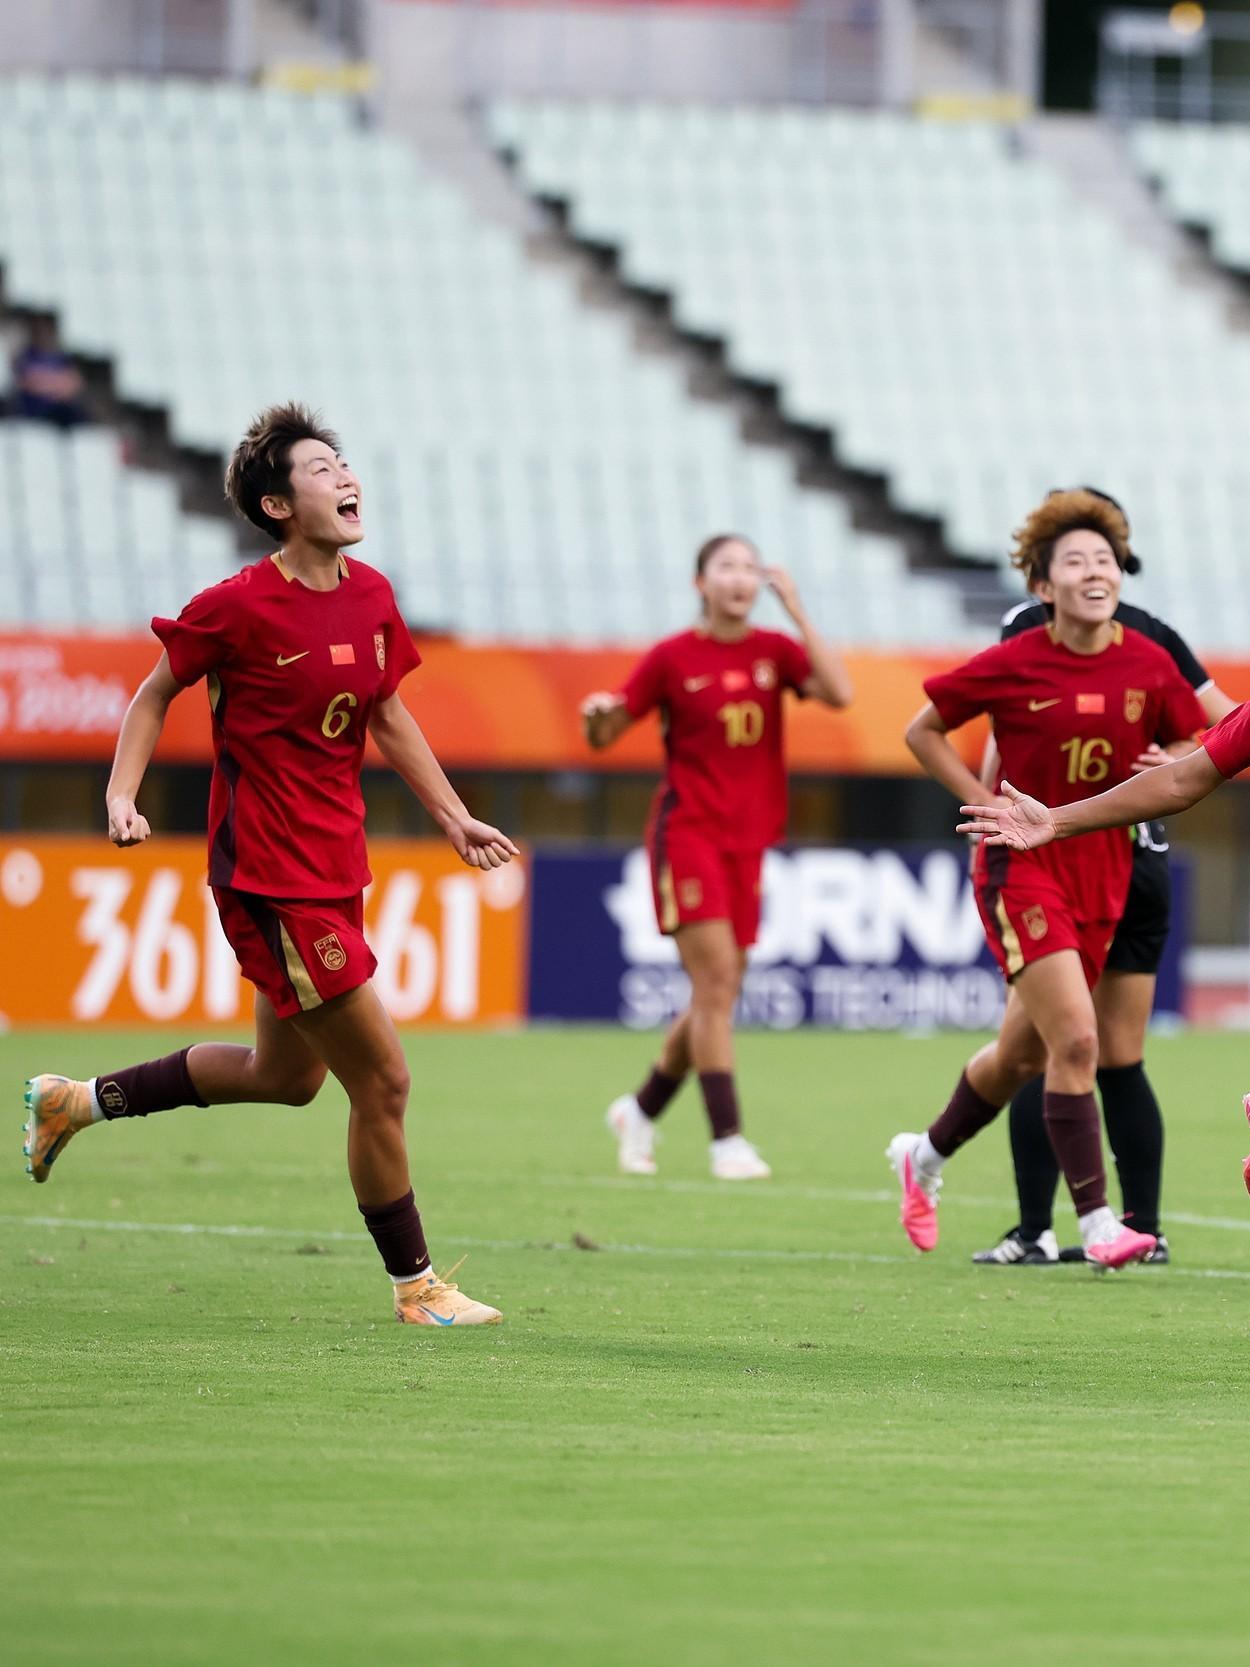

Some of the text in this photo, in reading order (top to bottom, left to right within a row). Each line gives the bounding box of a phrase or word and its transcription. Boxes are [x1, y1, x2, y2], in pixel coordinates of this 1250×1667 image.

[322, 692, 357, 738] 6
[718, 701, 763, 746] 10
[1060, 737, 1113, 783] 16
[70, 867, 241, 1020] 361
